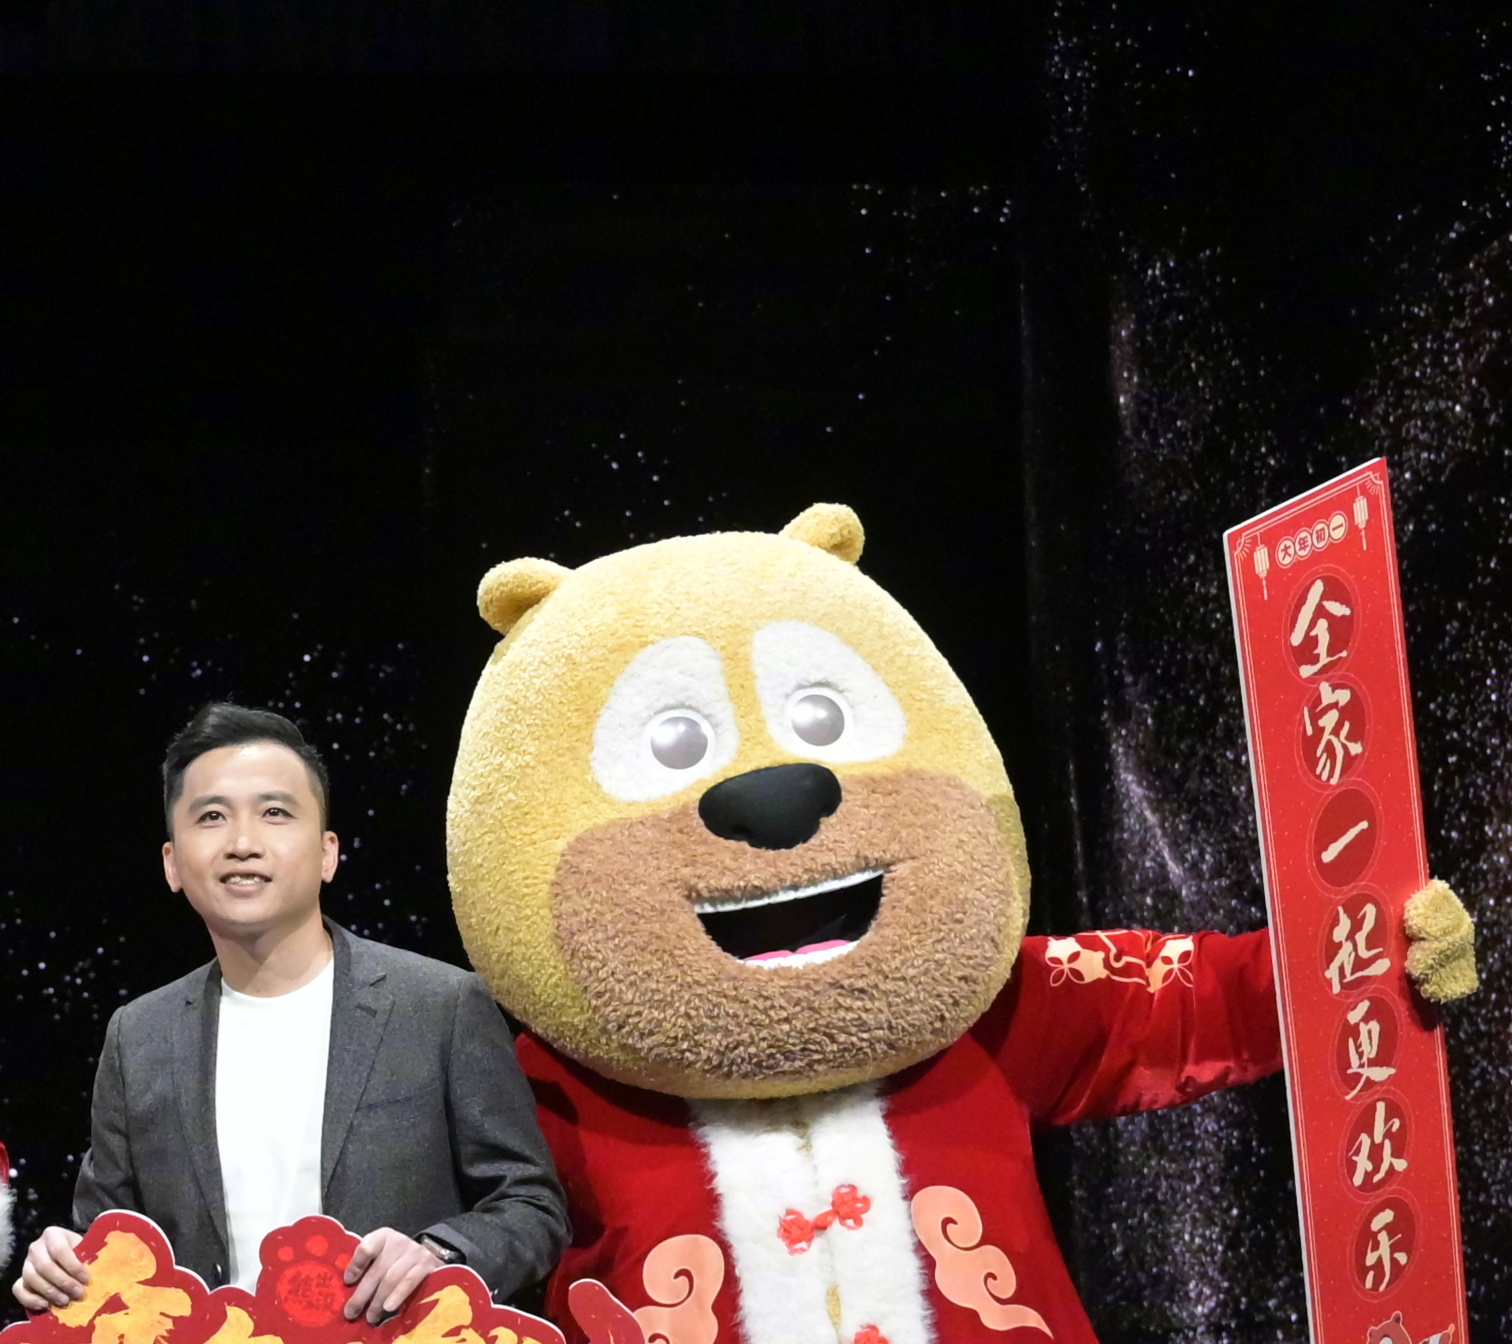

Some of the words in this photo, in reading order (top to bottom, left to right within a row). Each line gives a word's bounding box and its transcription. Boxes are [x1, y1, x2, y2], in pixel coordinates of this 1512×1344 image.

[1280, 520, 1344, 562] 大年初一
[1290, 578, 1409, 1292] 全家一起更欢乐
